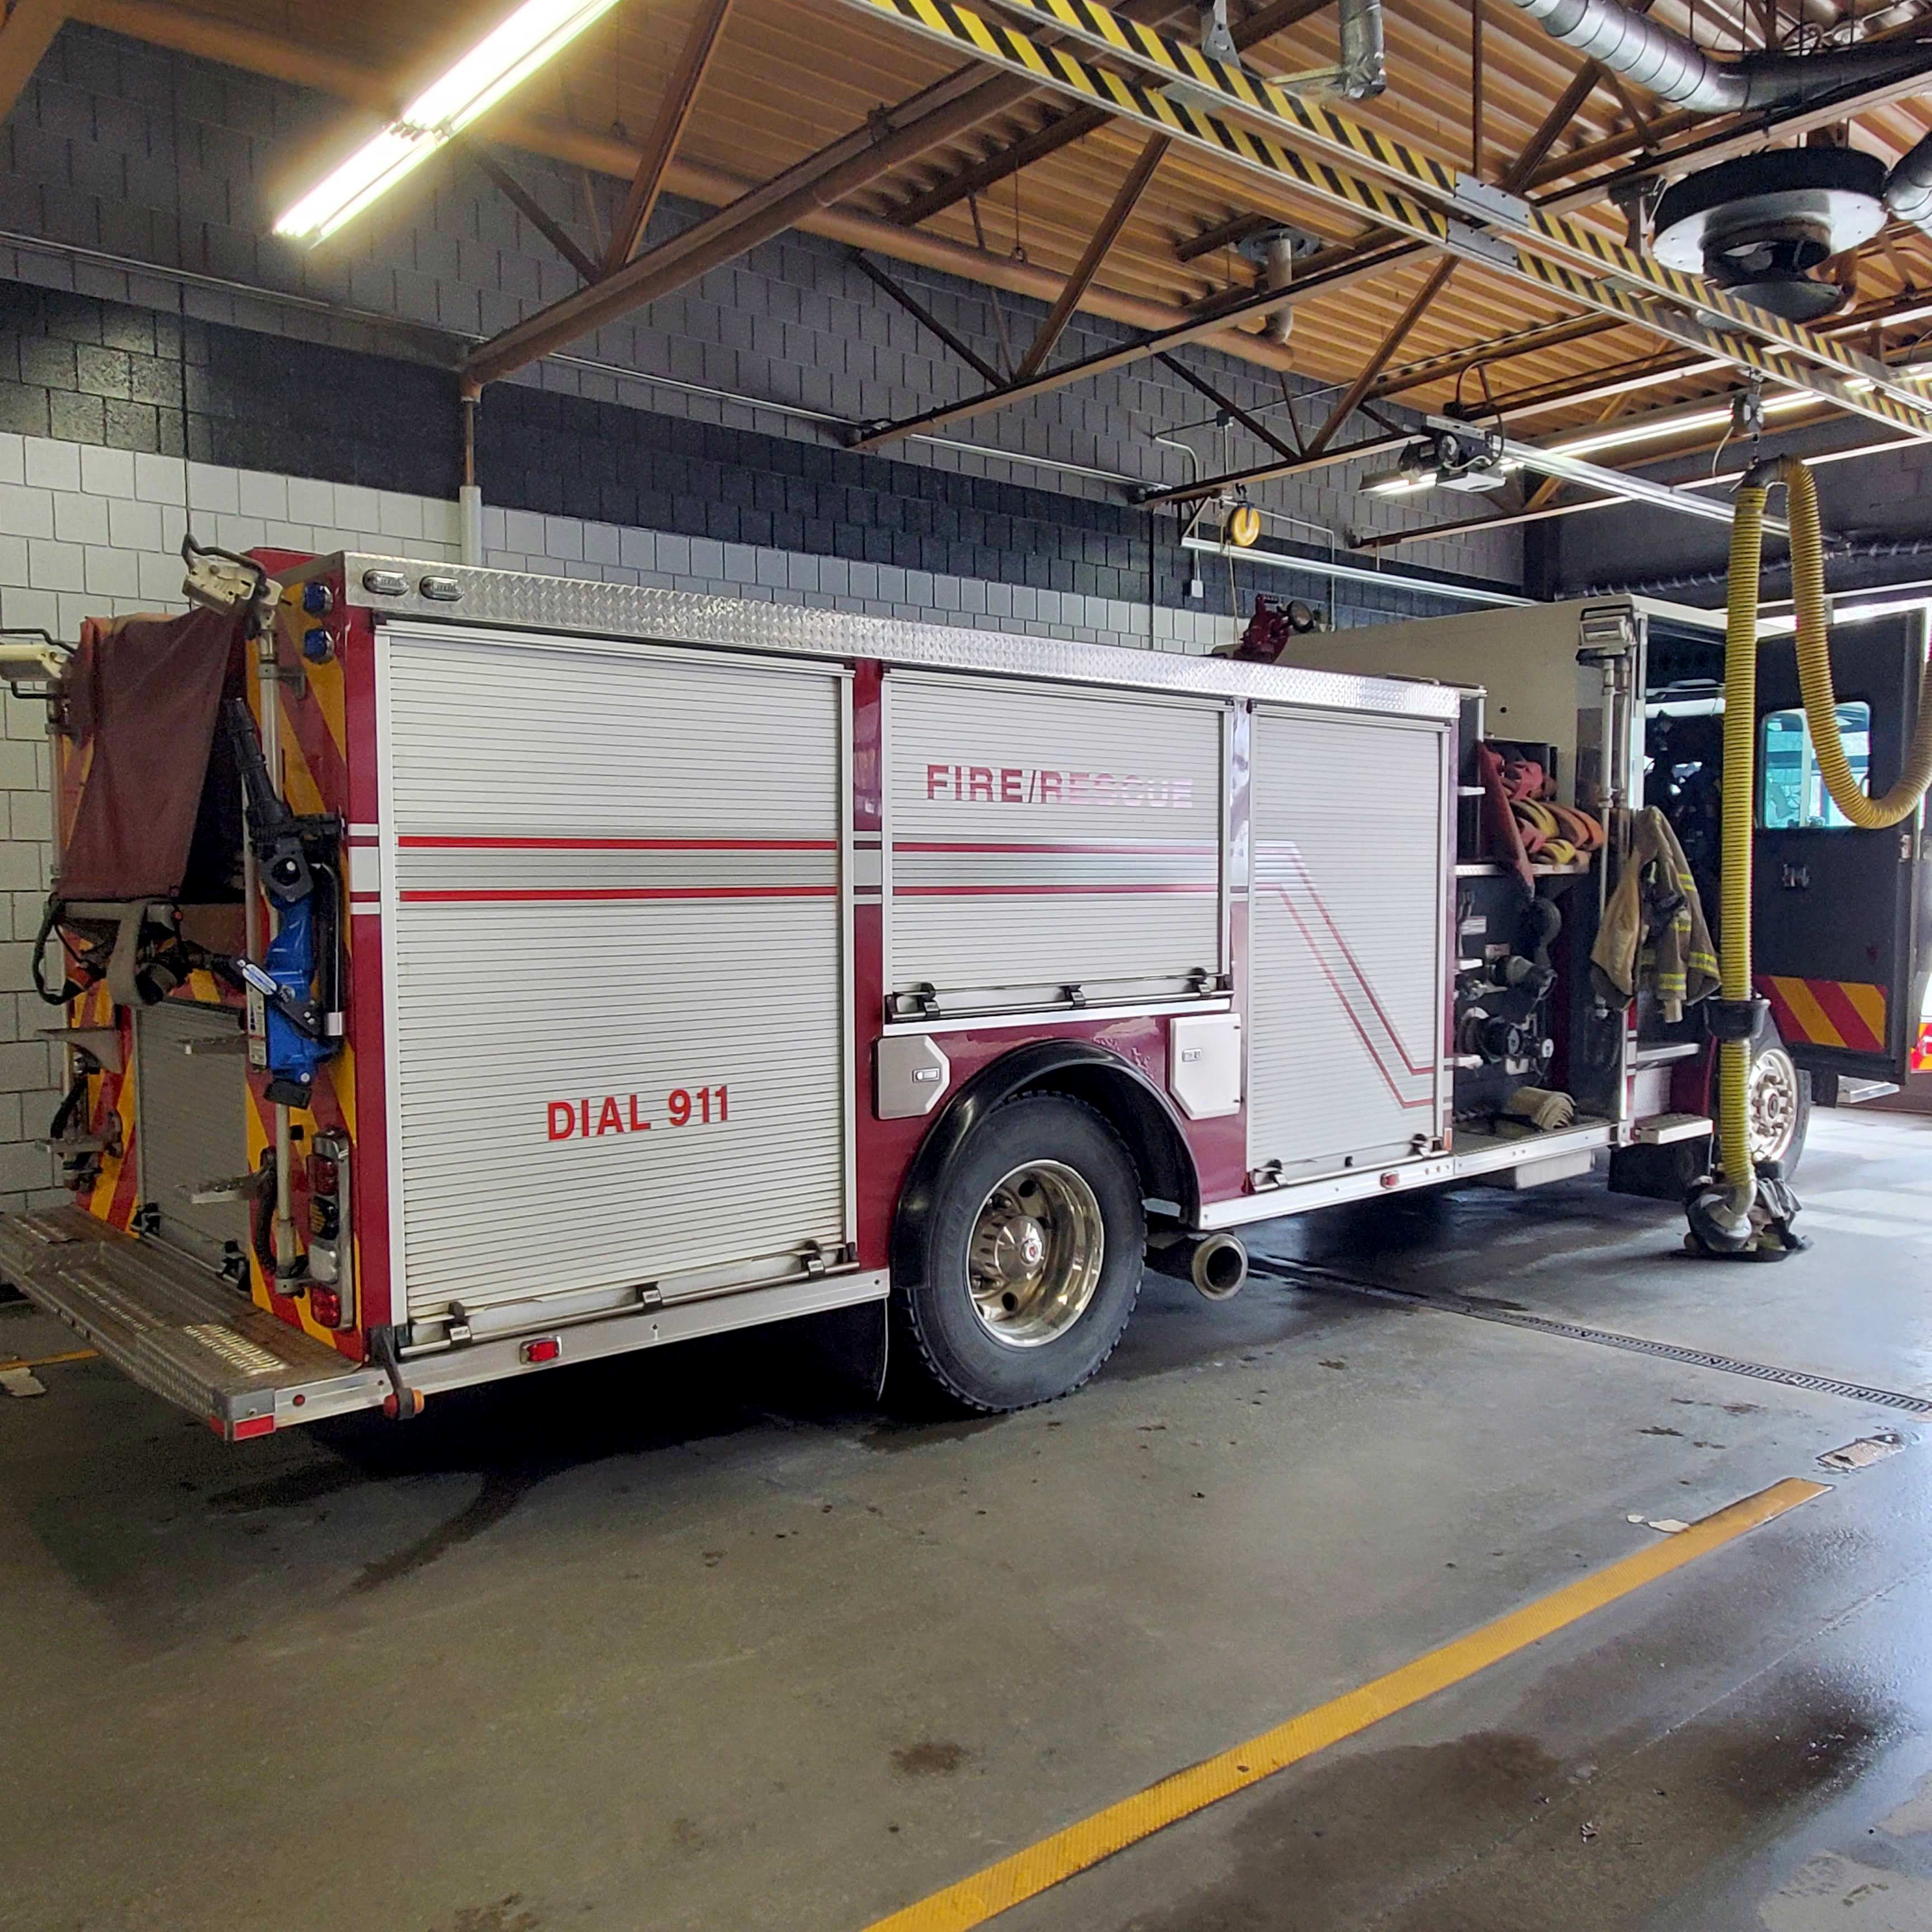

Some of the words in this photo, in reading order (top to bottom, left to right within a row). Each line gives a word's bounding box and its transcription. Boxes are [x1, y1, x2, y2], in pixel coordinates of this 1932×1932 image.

[927, 764, 1194, 808] FIRE/RESCUE
[547, 1094, 651, 1141] DIAL
[668, 1085, 728, 1126] 911
